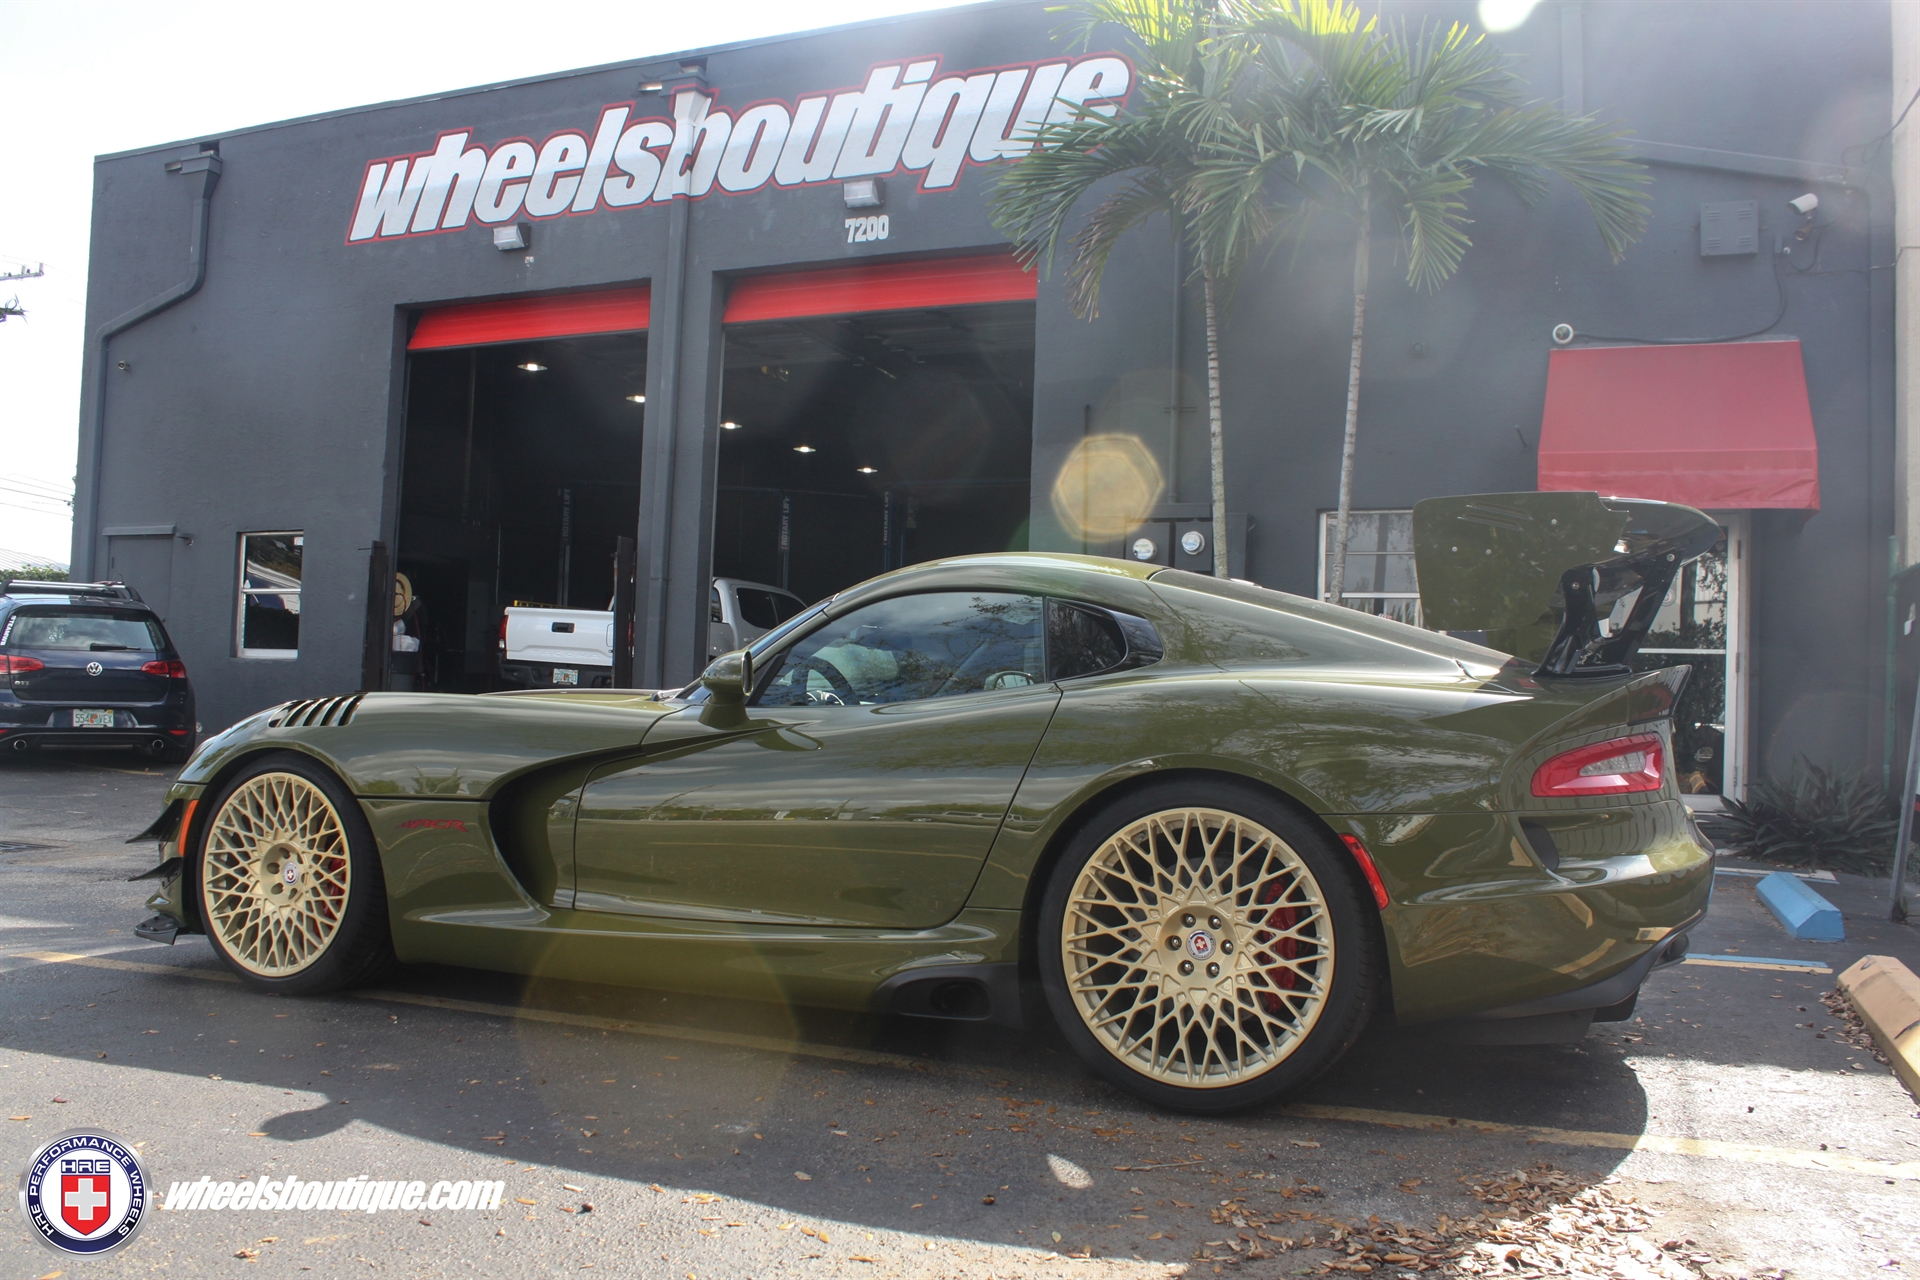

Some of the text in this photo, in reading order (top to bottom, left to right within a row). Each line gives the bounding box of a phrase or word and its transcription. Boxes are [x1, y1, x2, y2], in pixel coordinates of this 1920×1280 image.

[347, 55, 1132, 243] wheelsboutique
[844, 214, 889, 243] 7200
[562, 506, 570, 537] ROTARY
[781, 515, 789, 546] ROTARY
[530, 649, 600, 660] TACOMA
[410, 818, 468, 832] ACR
